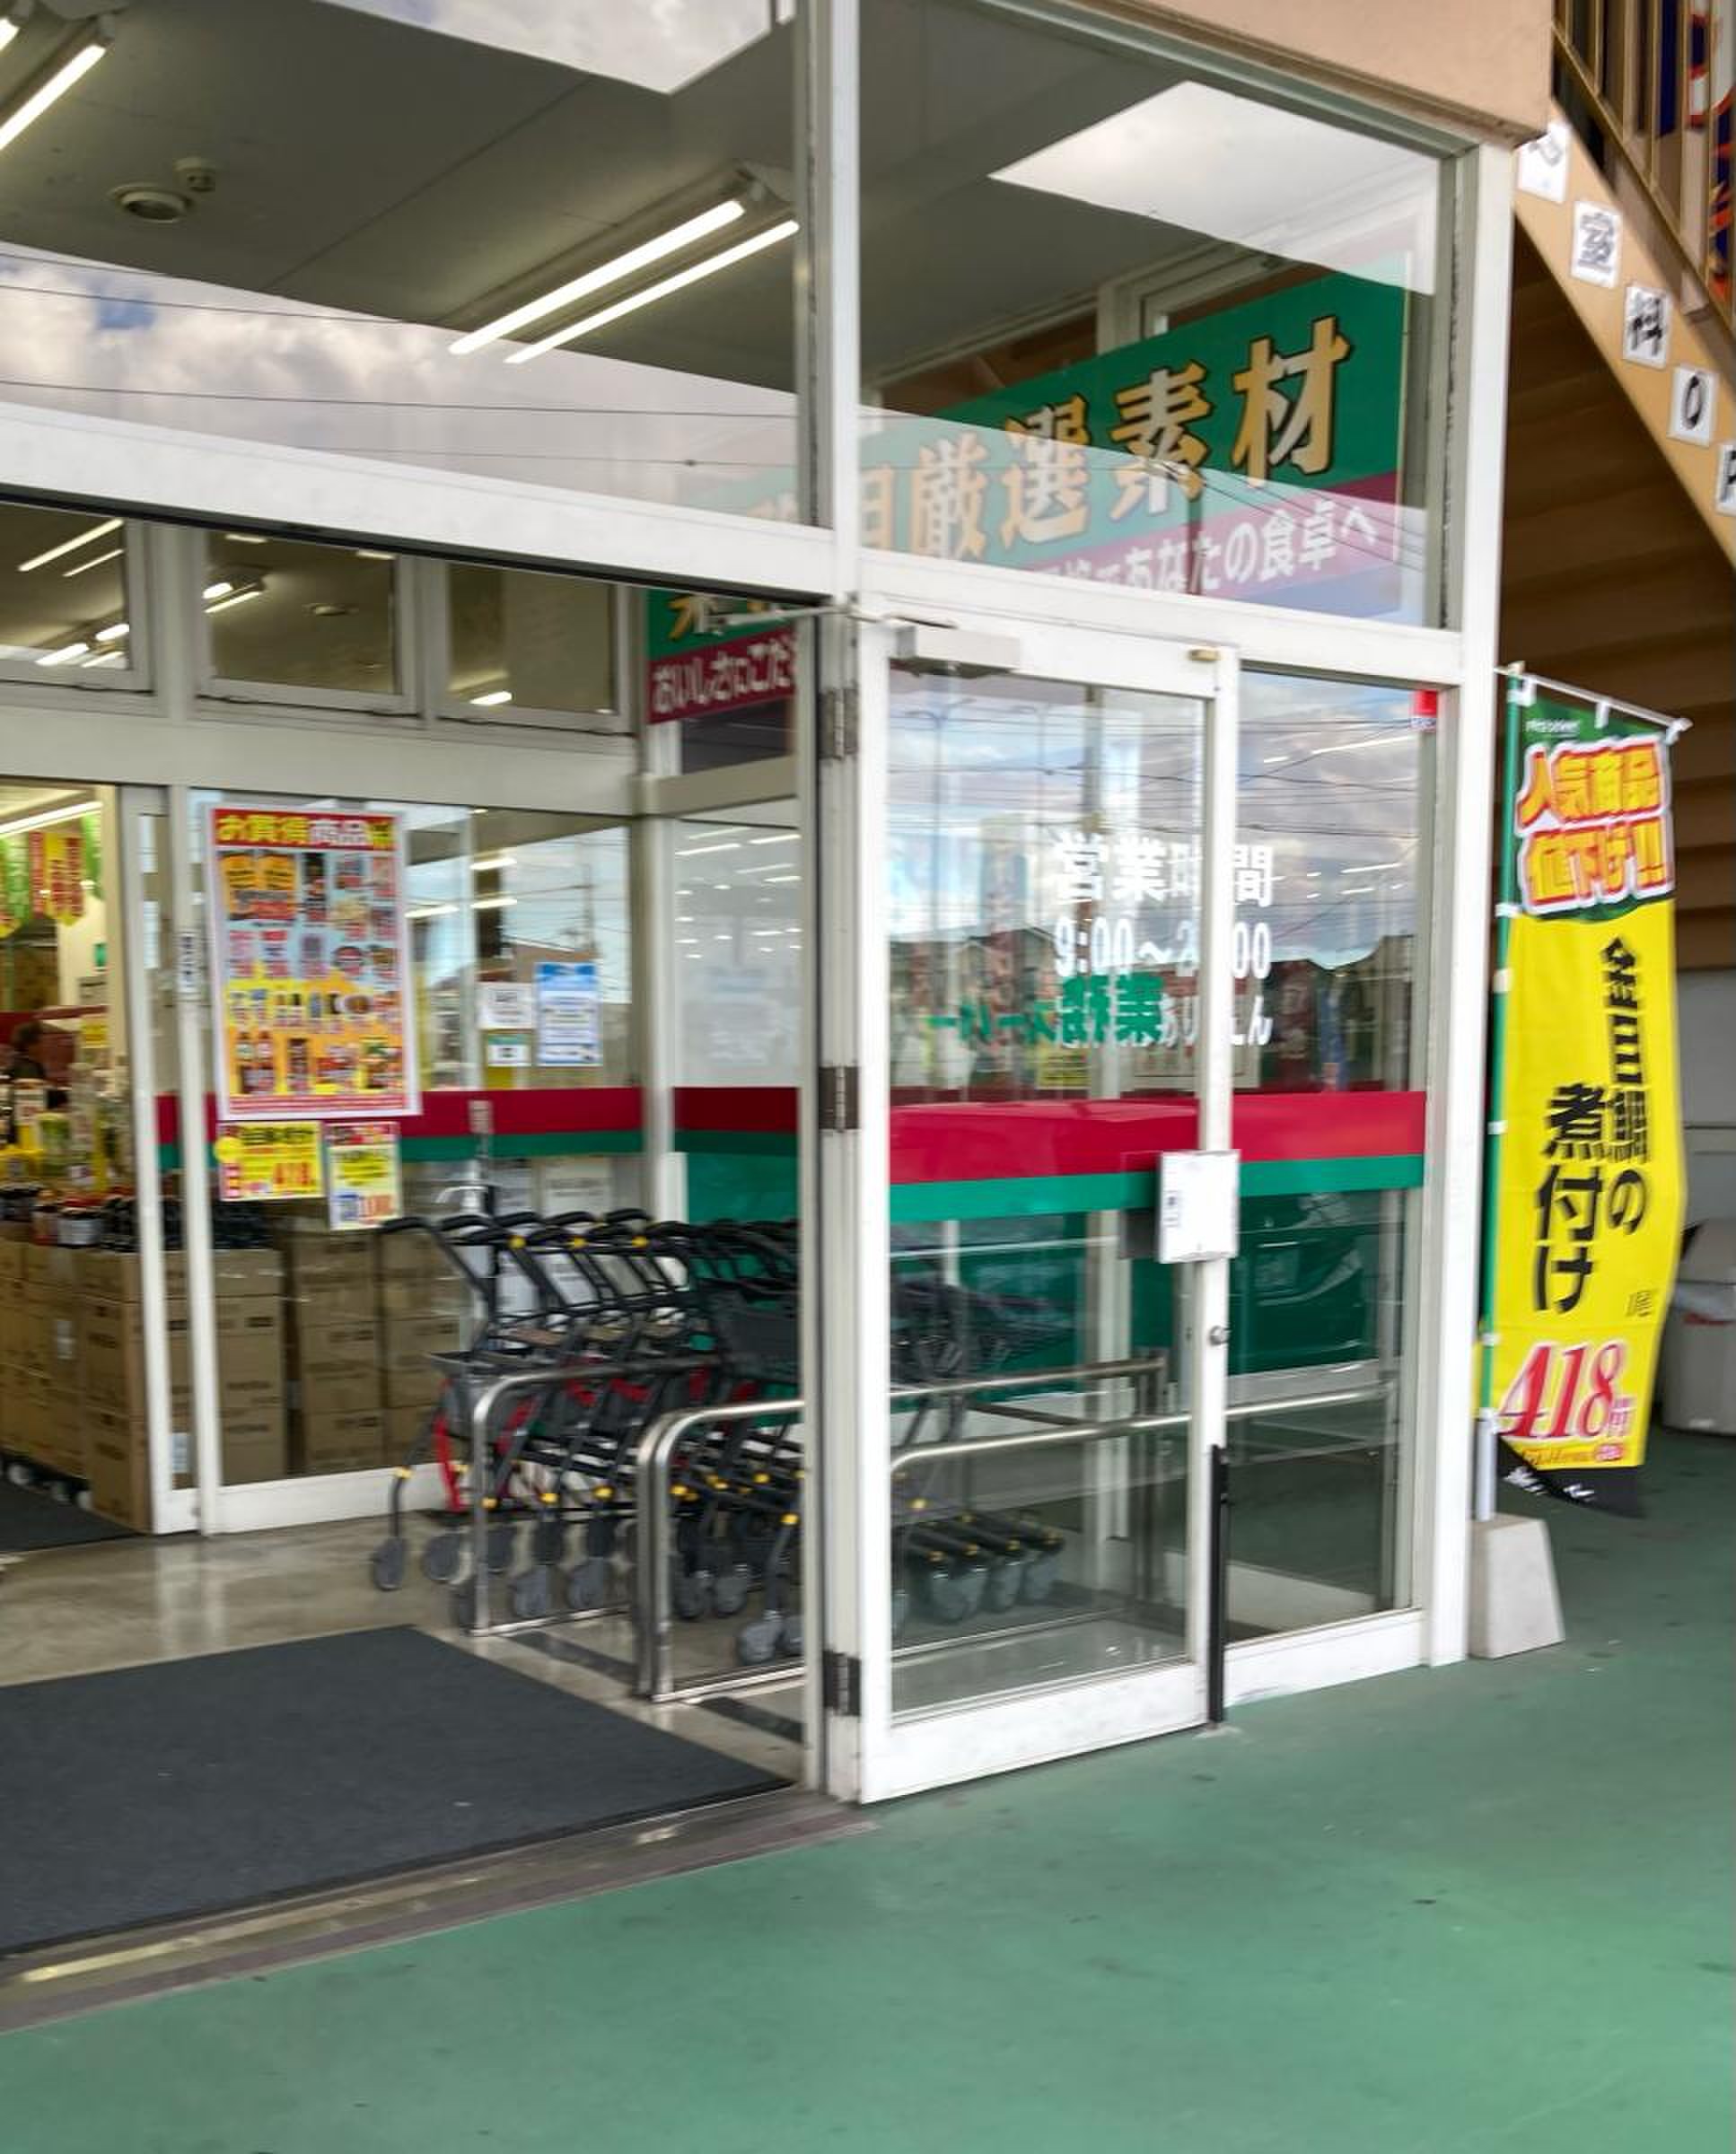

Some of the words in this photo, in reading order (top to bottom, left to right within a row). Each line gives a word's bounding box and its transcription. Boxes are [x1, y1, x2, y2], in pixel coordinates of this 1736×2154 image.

[1516, 740, 1664, 829] 人気商品
[1534, 1081, 1605, 1313] 煮付け
